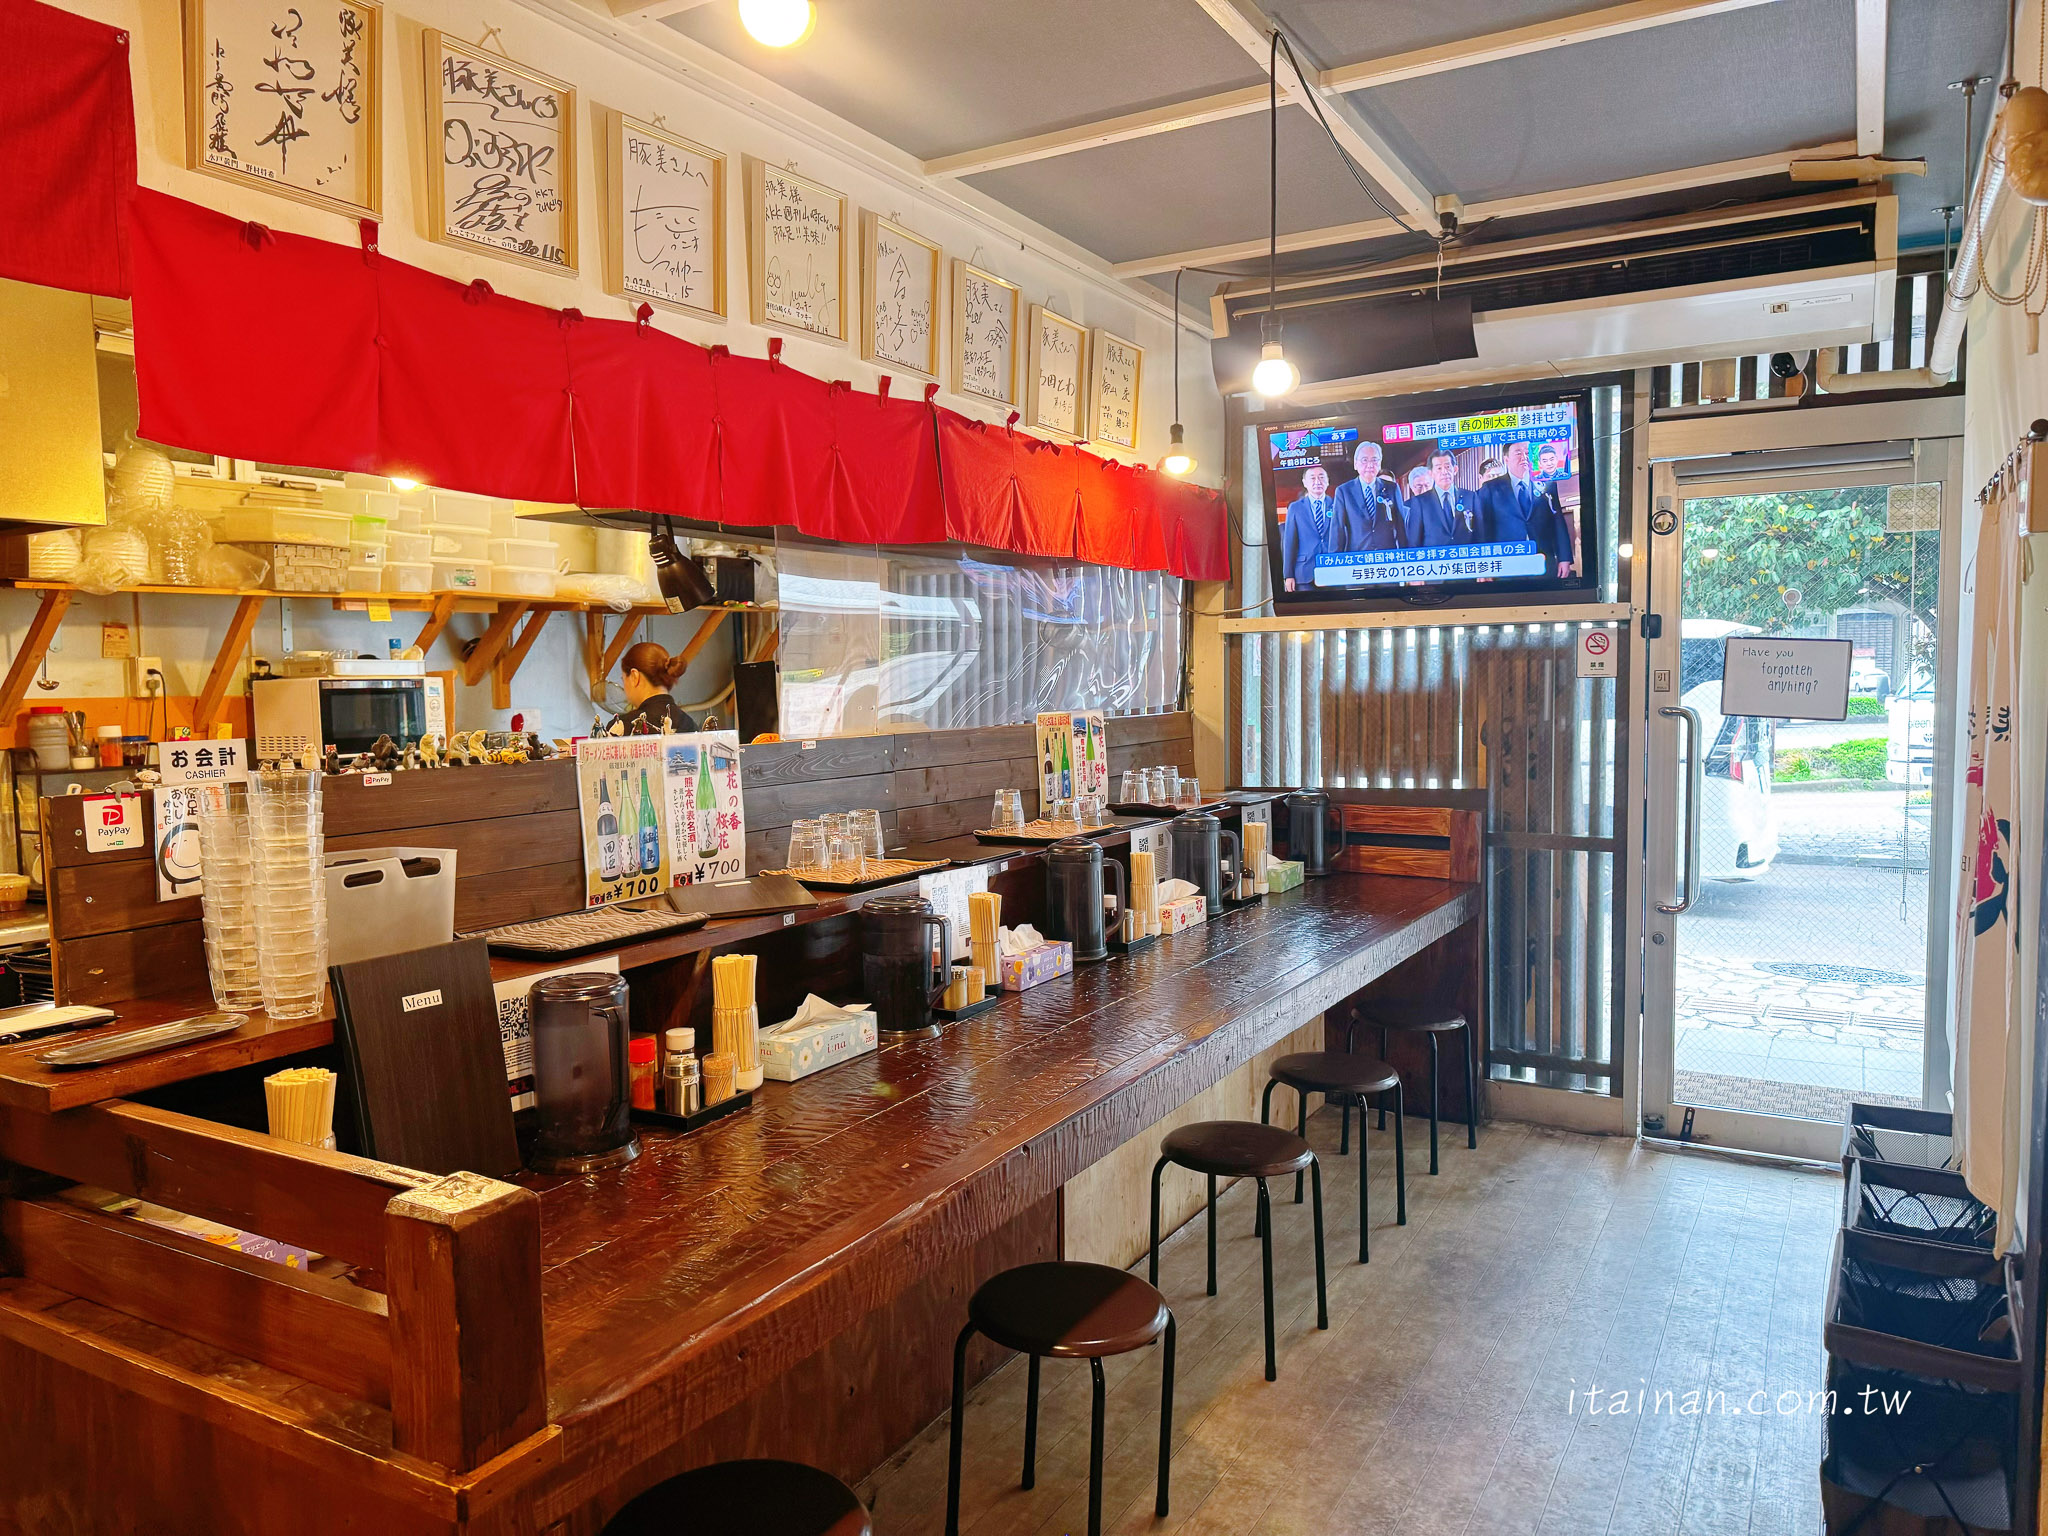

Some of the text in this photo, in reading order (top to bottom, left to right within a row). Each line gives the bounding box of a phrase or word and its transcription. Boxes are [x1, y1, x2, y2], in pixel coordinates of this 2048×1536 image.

[629, 137, 709, 187] 豚美さんへ
[1415, 421, 1458, 437] 高市総理
[1460, 414, 1518, 432] 春の例大祭
[1520, 410, 1568, 426] 参拝せず
[1285, 437, 1308, 448] 2:25
[1331, 432, 1347, 441] あす
[1280, 456, 1321, 468] 午前8時ごろ
[1318, 543, 1533, 567] 「みんなで靖国神社に参拝する国会議員の会」
[1351, 560, 1503, 580] 与野党の126人が集団参拝
[1742, 647, 1794, 660] Have you
[1761, 661, 1813, 678] forgotten
[170, 746, 237, 768] お会計
[185, 769, 226, 780] CASHIER
[171, 788, 184, 820] おいし
[726, 771, 742, 830] 花の香
[684, 776, 697, 854] 熊本代表名酒!
[97, 826, 131, 837] PayPay
[716, 811, 730, 851] 桜花
[694, 858, 740, 883] ¥700
[614, 876, 659, 898] ¥700
[404, 993, 441, 1011] Menu
